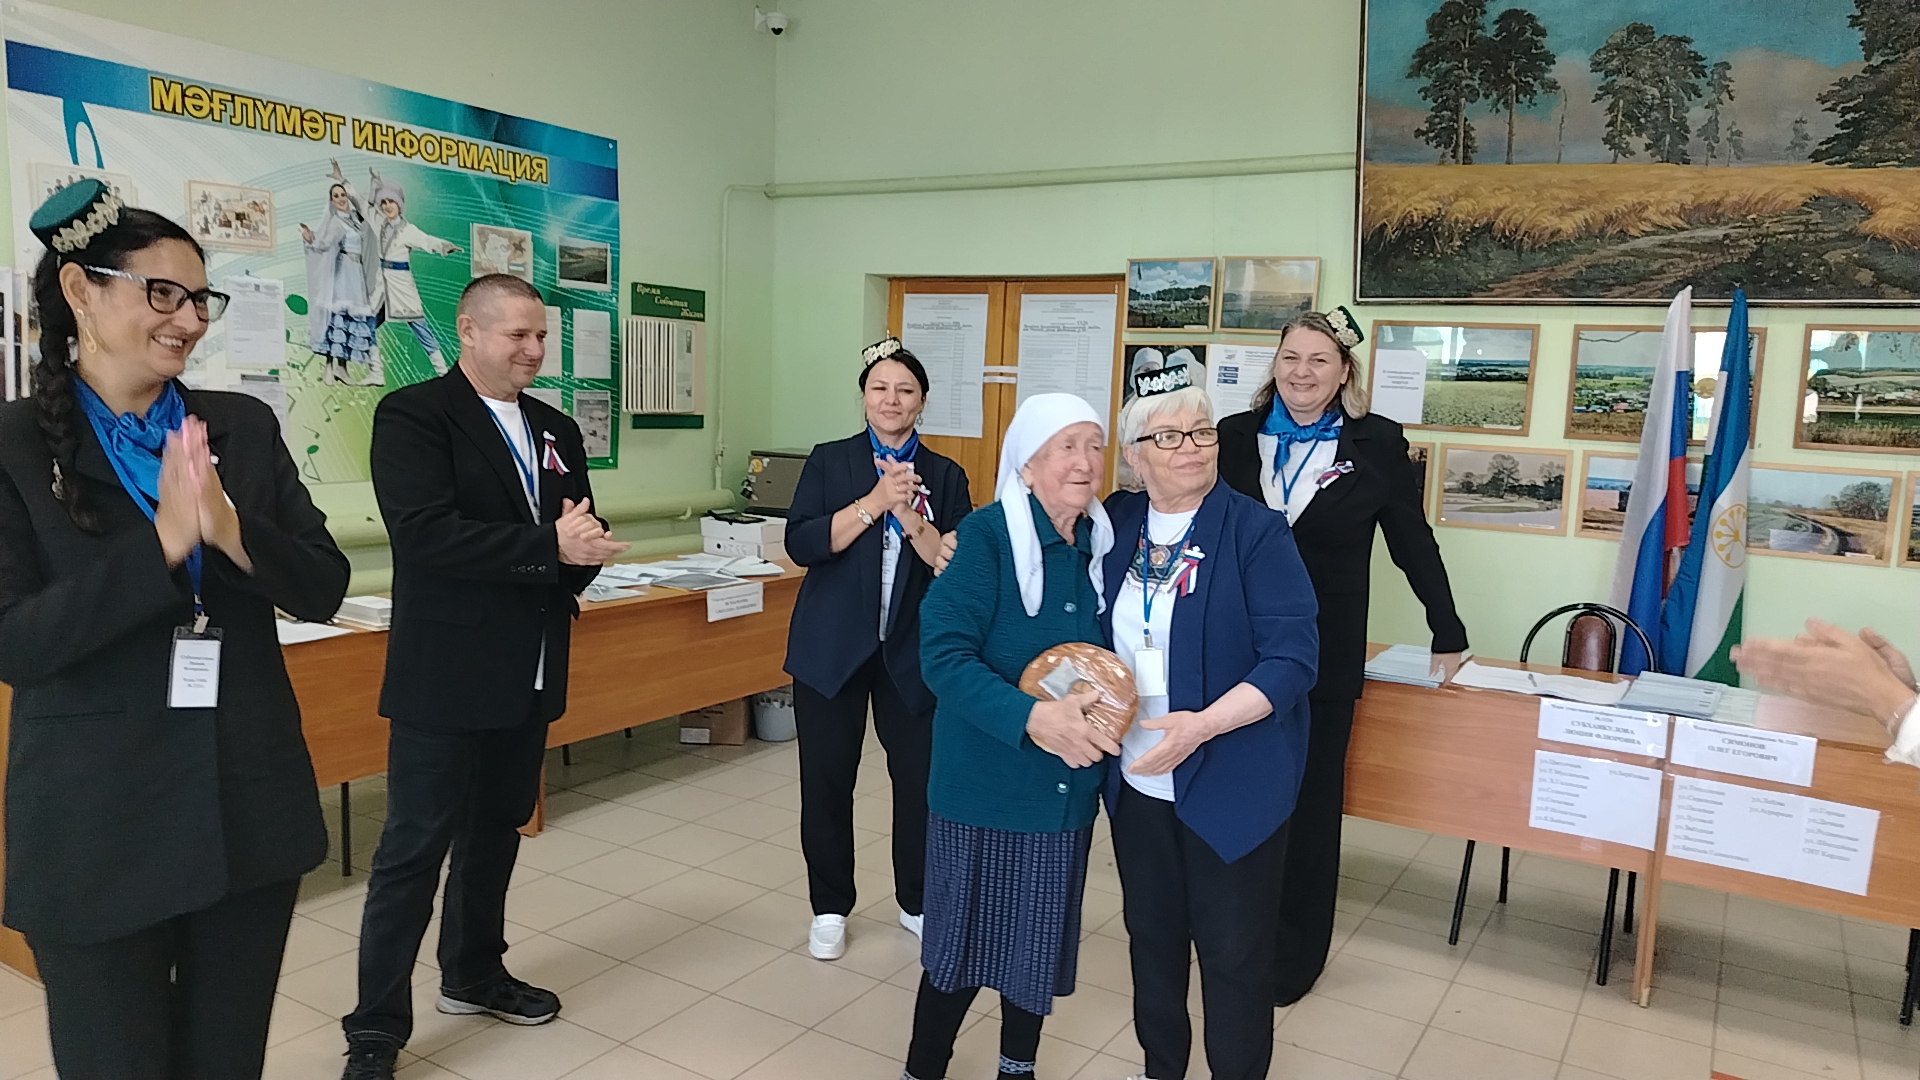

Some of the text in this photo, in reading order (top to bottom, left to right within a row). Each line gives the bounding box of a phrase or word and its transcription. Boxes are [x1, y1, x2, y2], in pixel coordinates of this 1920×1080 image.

[150, 76, 549, 183] МӘҒЛҮМӘТ ИНФОРМАЦИЯ
[636, 283, 661, 296] Время
[654, 295, 688, 308] События
